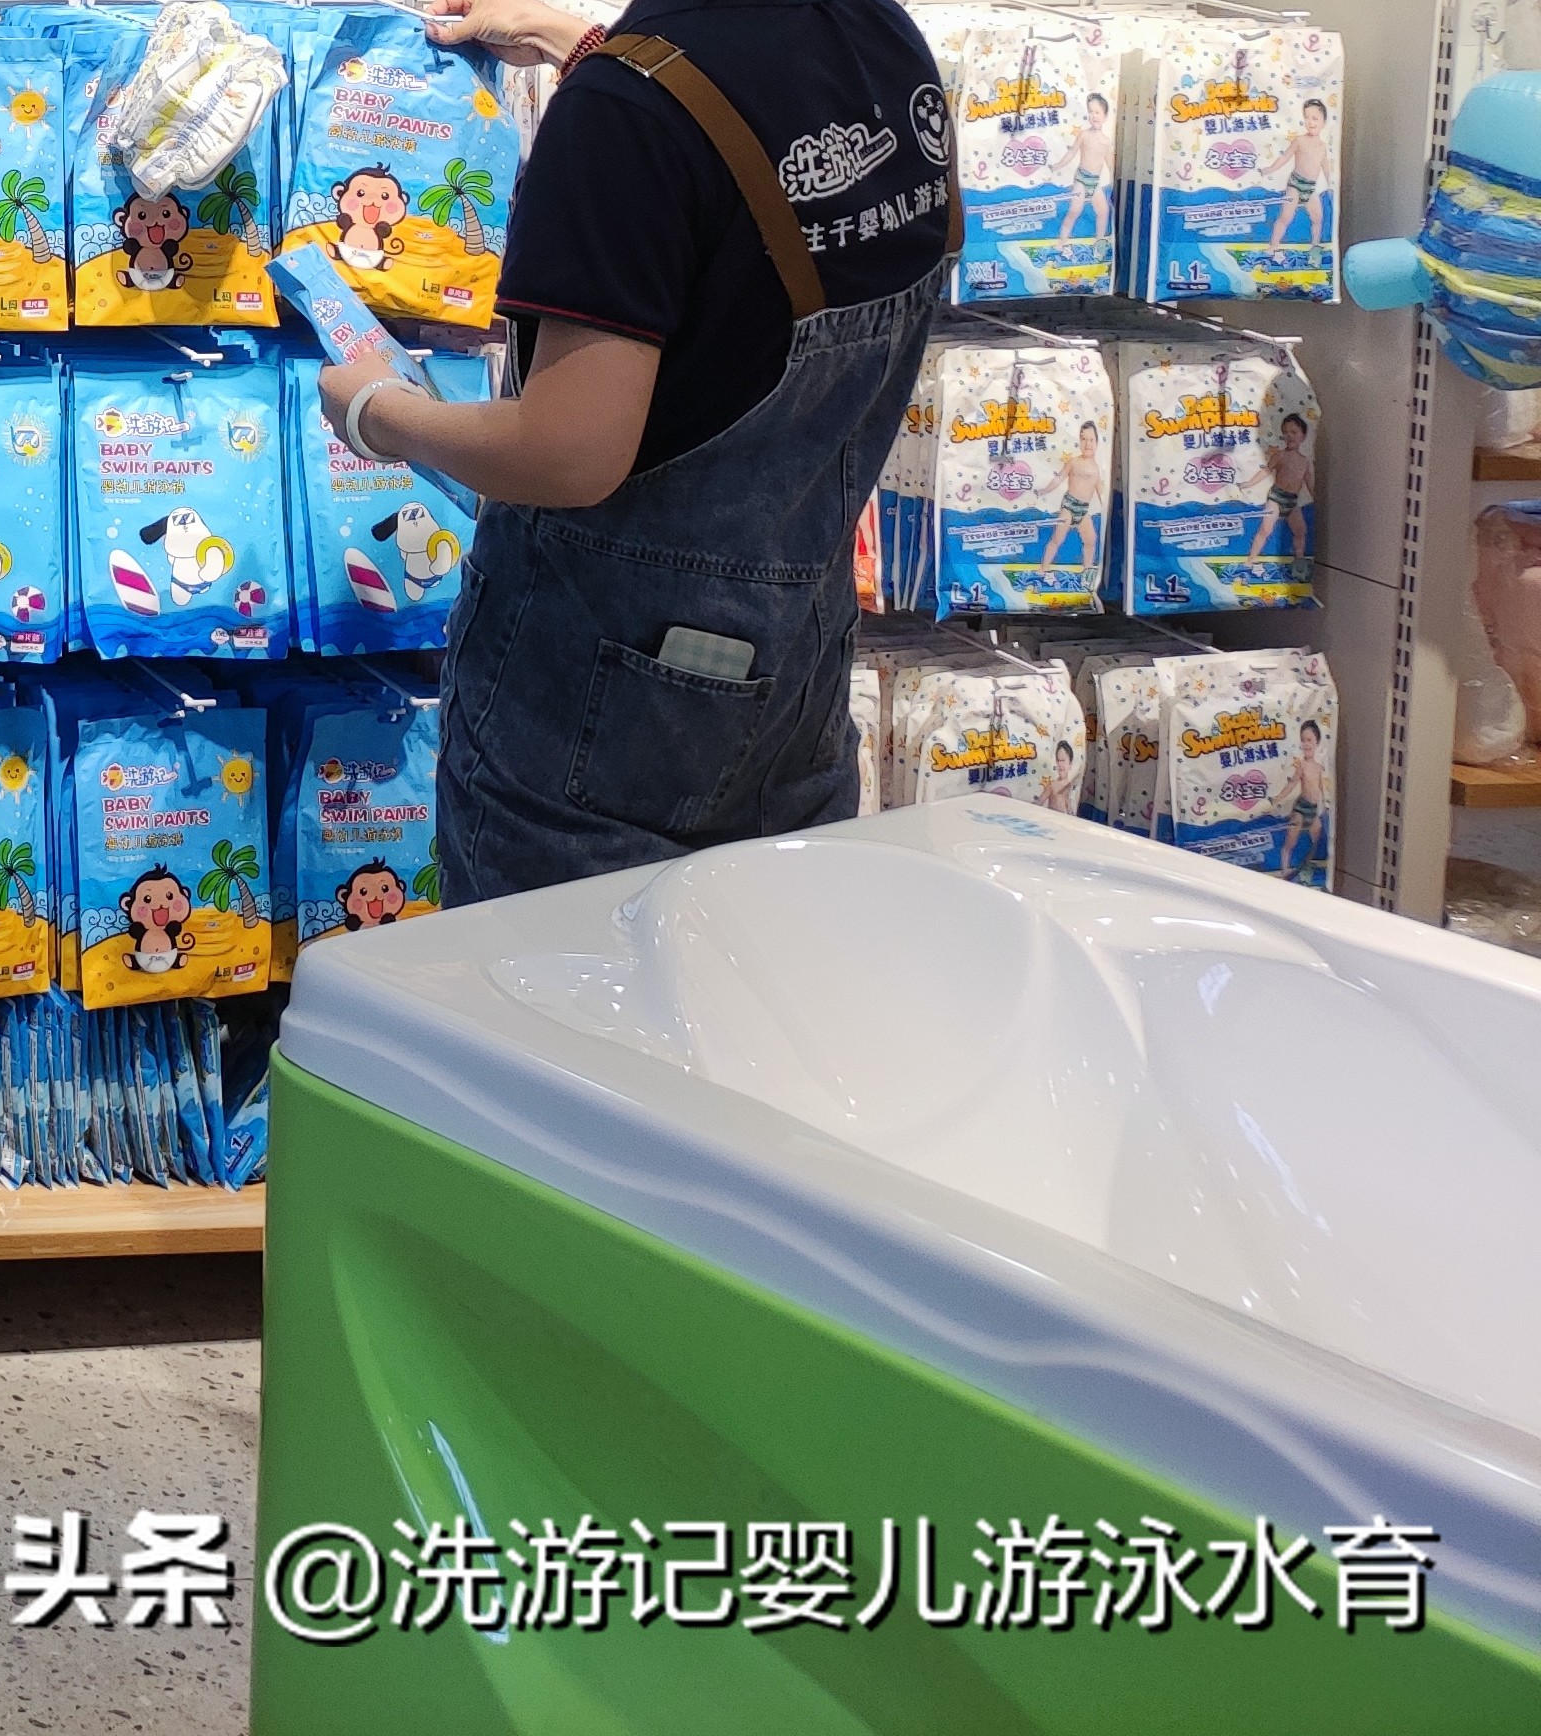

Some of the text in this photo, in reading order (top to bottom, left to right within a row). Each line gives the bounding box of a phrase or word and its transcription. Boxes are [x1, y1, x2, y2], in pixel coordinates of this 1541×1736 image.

[334, 87, 394, 109] BABY
[330, 105, 452, 139] SWIM PANTS
[99, 442, 153, 457] BABY
[327, 442, 350, 455] BA
[100, 460, 214, 475] SWIM PANTS
[329, 458, 376, 472] SWIM
[102, 795, 153, 813] BABY
[318, 790, 371, 805] BABY
[104, 810, 210, 831] SWIM PANTS
[320, 805, 428, 823] SWIM PANTS
